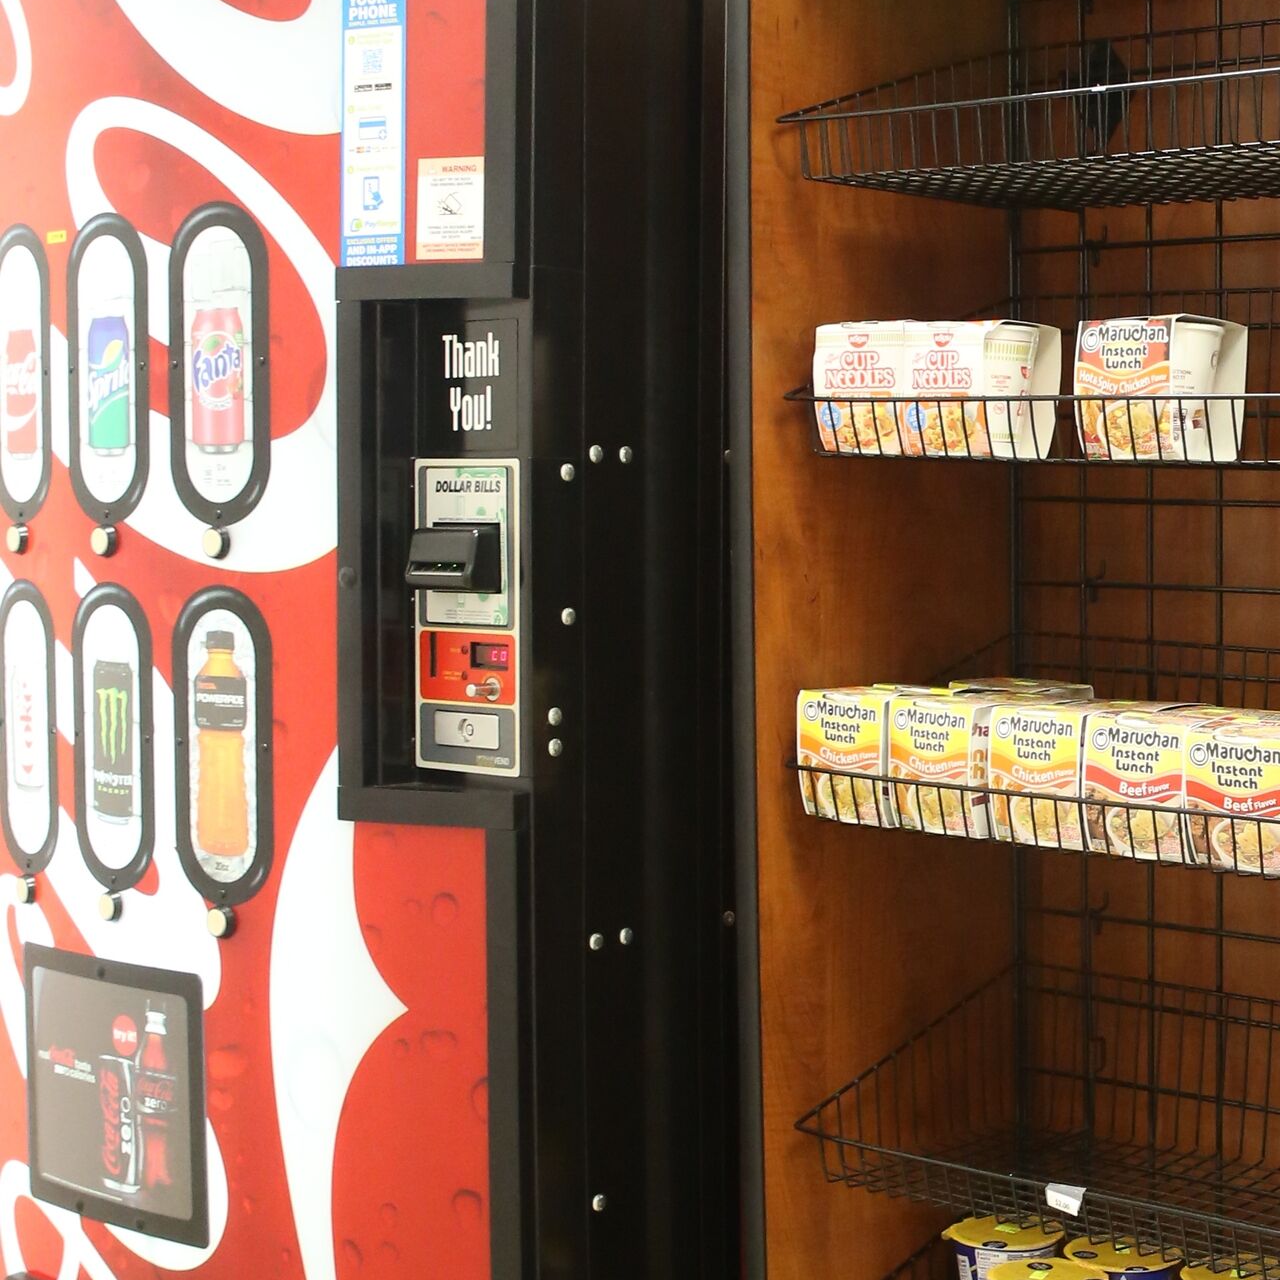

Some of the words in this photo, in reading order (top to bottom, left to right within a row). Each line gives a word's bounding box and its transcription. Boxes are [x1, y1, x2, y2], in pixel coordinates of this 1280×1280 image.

[349, 4, 397, 21] PHONE
[442, 164, 477, 173] WARNING
[347, 245, 366, 255] AND
[367, 244, 398, 254] IN-APP
[346, 255, 398, 266] DISCOUNTS
[1099, 326, 1165, 342] Maruchan
[442, 332, 500, 379] Thank
[1102, 345, 1147, 357] Instant
[840, 351, 880, 370] CUP
[925, 351, 959, 370] CUP
[1106, 359, 1142, 369] Lunch
[825, 367, 896, 389] NOODLES
[912, 367, 972, 389] NOODLES
[1120, 378, 1151, 393] Chicken
[450, 385, 492, 431] You!
[435, 481, 472, 493] DOLLAR
[474, 481, 501, 493] BILLS
[196, 692, 245, 705] POWERADE
[817, 700, 876, 721] Maruchan
[820, 718, 860, 733] Instant
[907, 708, 965, 729] Maruchan
[910, 726, 950, 741] Instant
[1010, 717, 1073, 737] Maruchan
[825, 731, 856, 744] Lunch
[914, 738, 945, 752] Lunch
[1013, 735, 1057, 750] Instant
[1108, 727, 1179, 750] Maruchan
[819, 746, 859, 764] Chicken
[1017, 748, 1051, 762] Lunch
[1111, 745, 1160, 762] Instant
[908, 755, 947, 772] Chicken
[1115, 760, 1153, 774] Lunch
[1211, 762, 1263, 778] Instant
[1011, 765, 1052, 783] Chicken
[1119, 781, 1147, 796] Beef
[1217, 775, 1258, 790] Lunch
[1223, 796, 1253, 812] Beef
[1254, 797, 1277, 810] Flavor
[144, 1098, 167, 1110] zero
